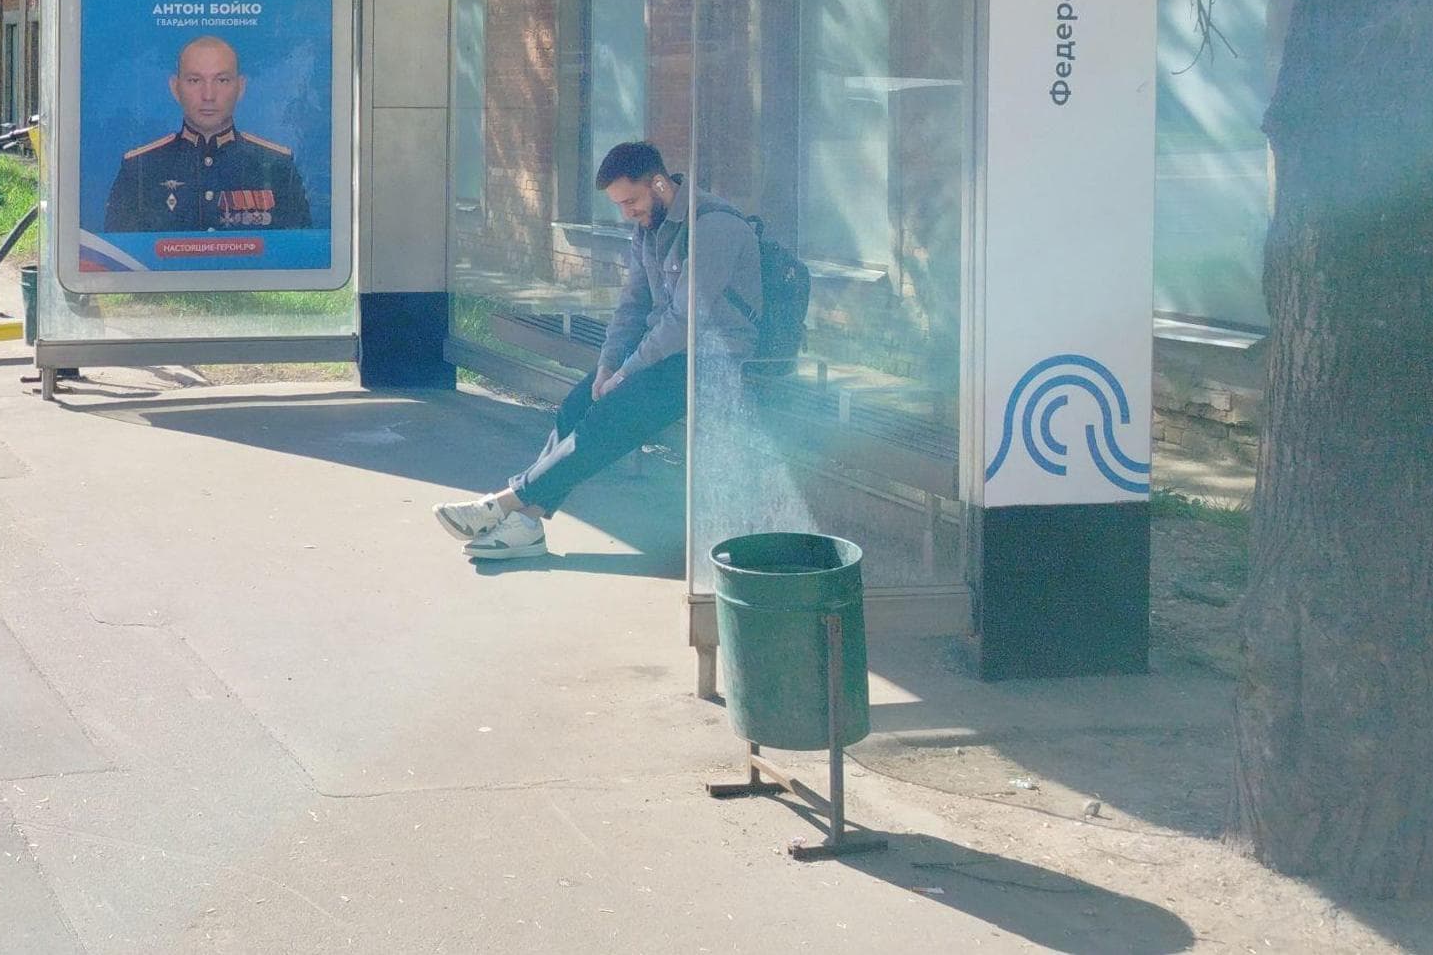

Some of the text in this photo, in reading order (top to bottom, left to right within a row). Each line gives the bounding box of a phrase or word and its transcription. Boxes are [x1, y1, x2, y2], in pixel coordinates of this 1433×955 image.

[152, 0, 262, 15] АНТОН БОЙКО
[156, 17, 258, 27] ГВАРДИИ ПОЛКОВНИК
